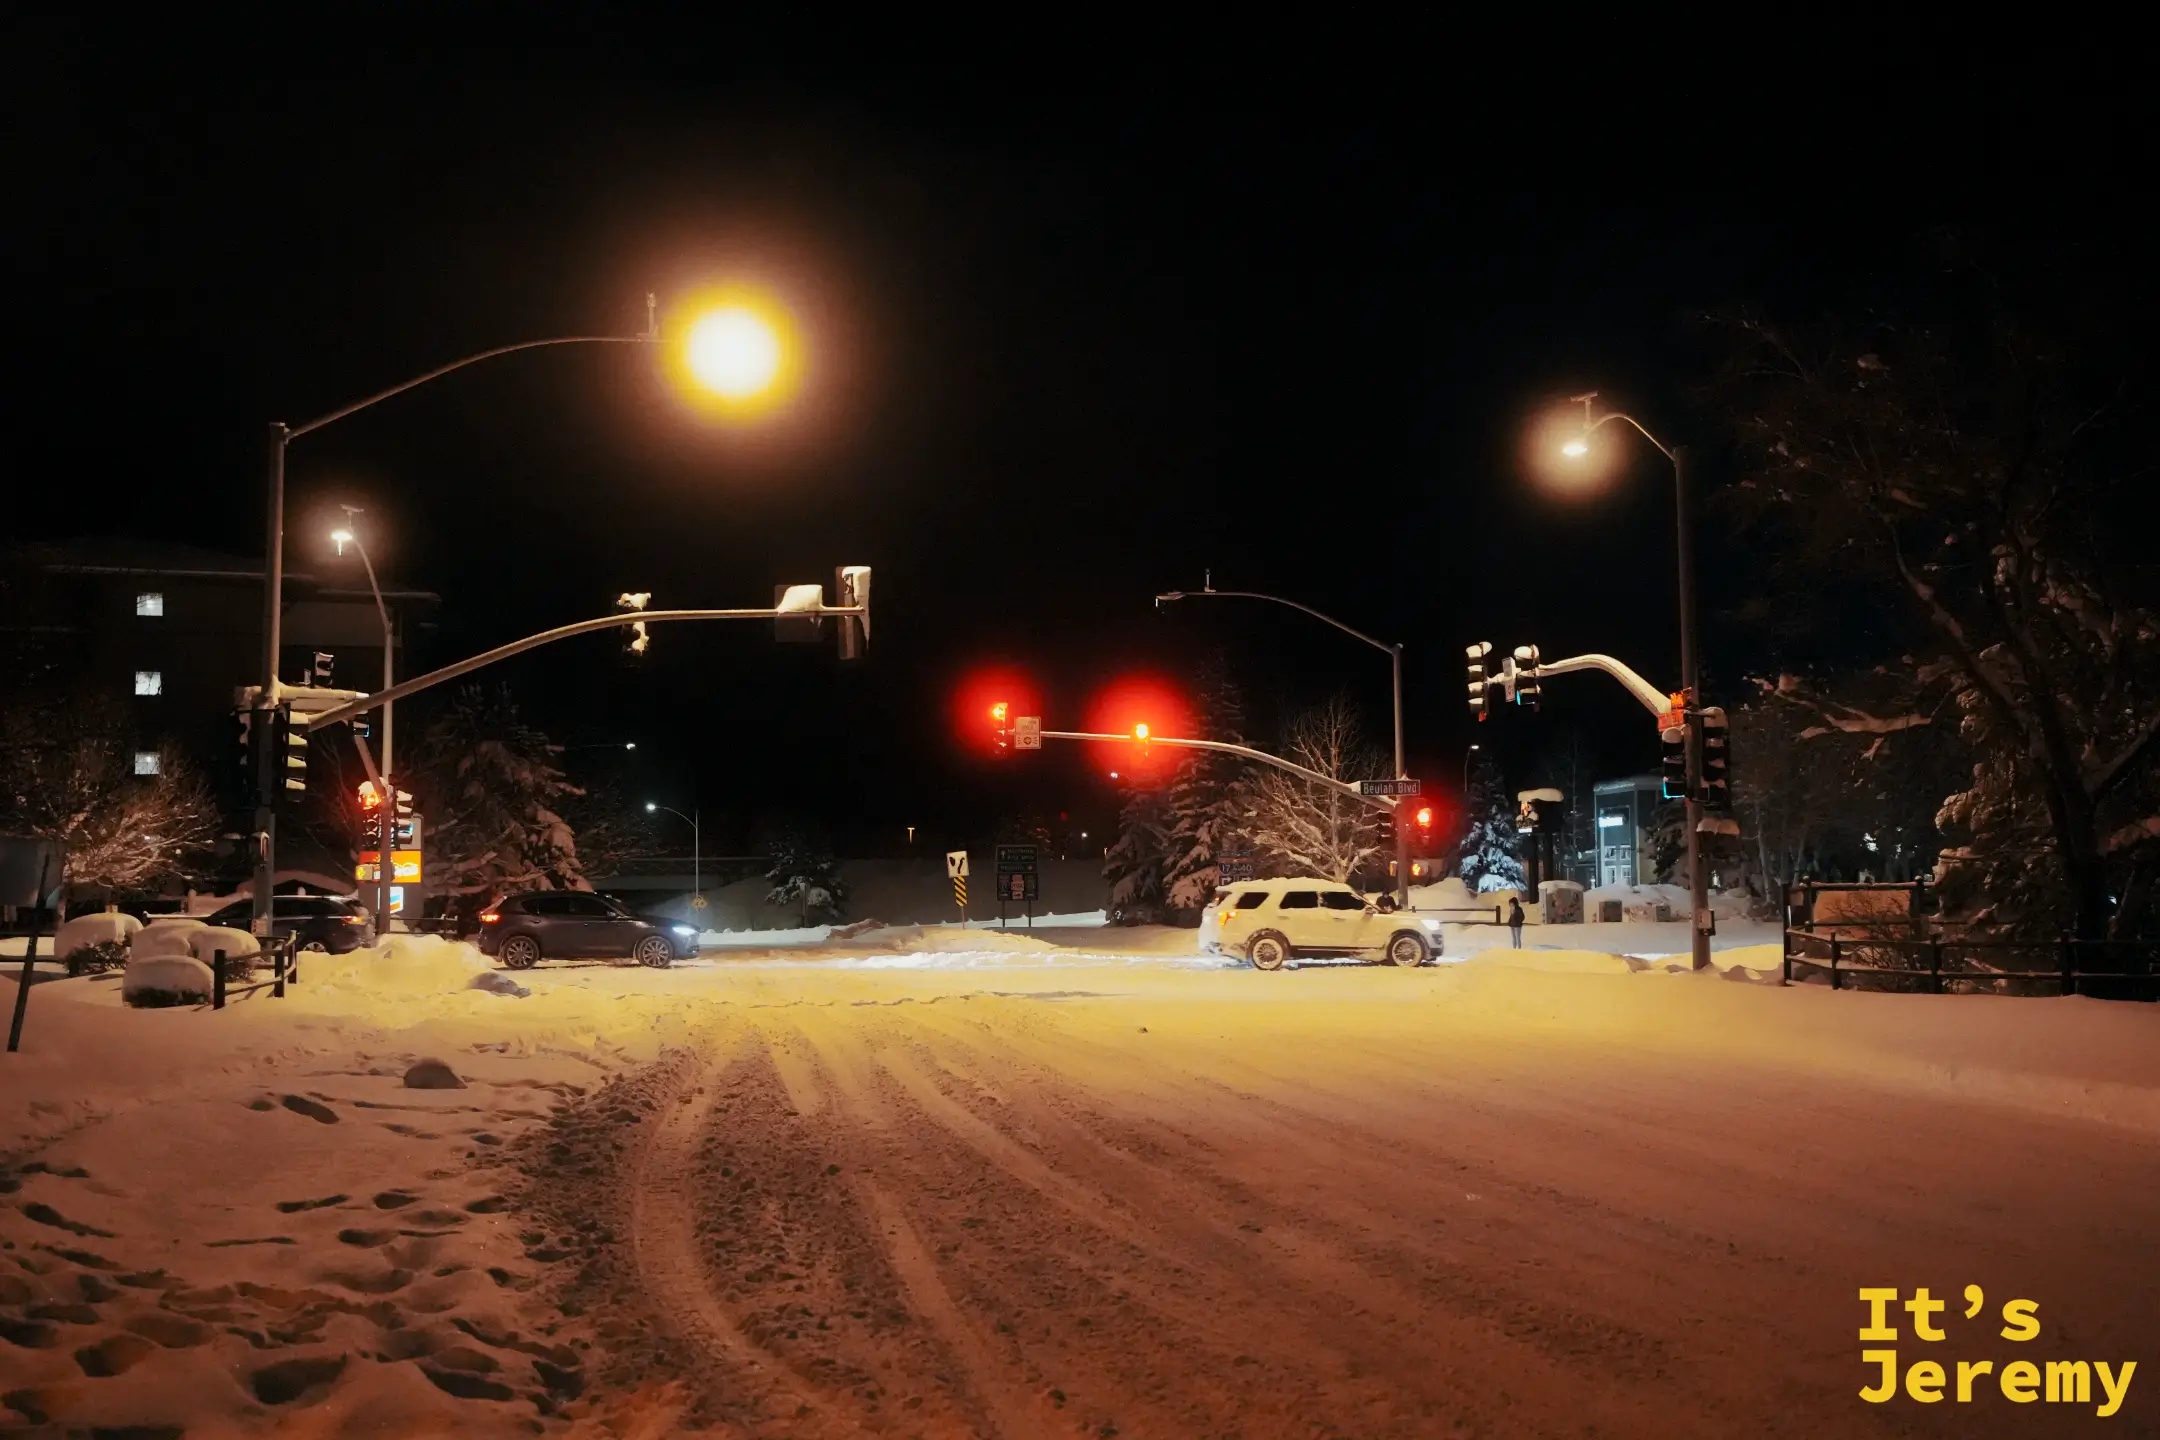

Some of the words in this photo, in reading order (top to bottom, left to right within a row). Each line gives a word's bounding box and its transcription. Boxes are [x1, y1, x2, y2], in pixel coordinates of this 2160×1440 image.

[1363, 782, 1394, 795] Beulah
[1397, 782, 1417, 794] Blvd
[1222, 864, 1231, 873] 17
[1240, 864, 1252, 872] 40
